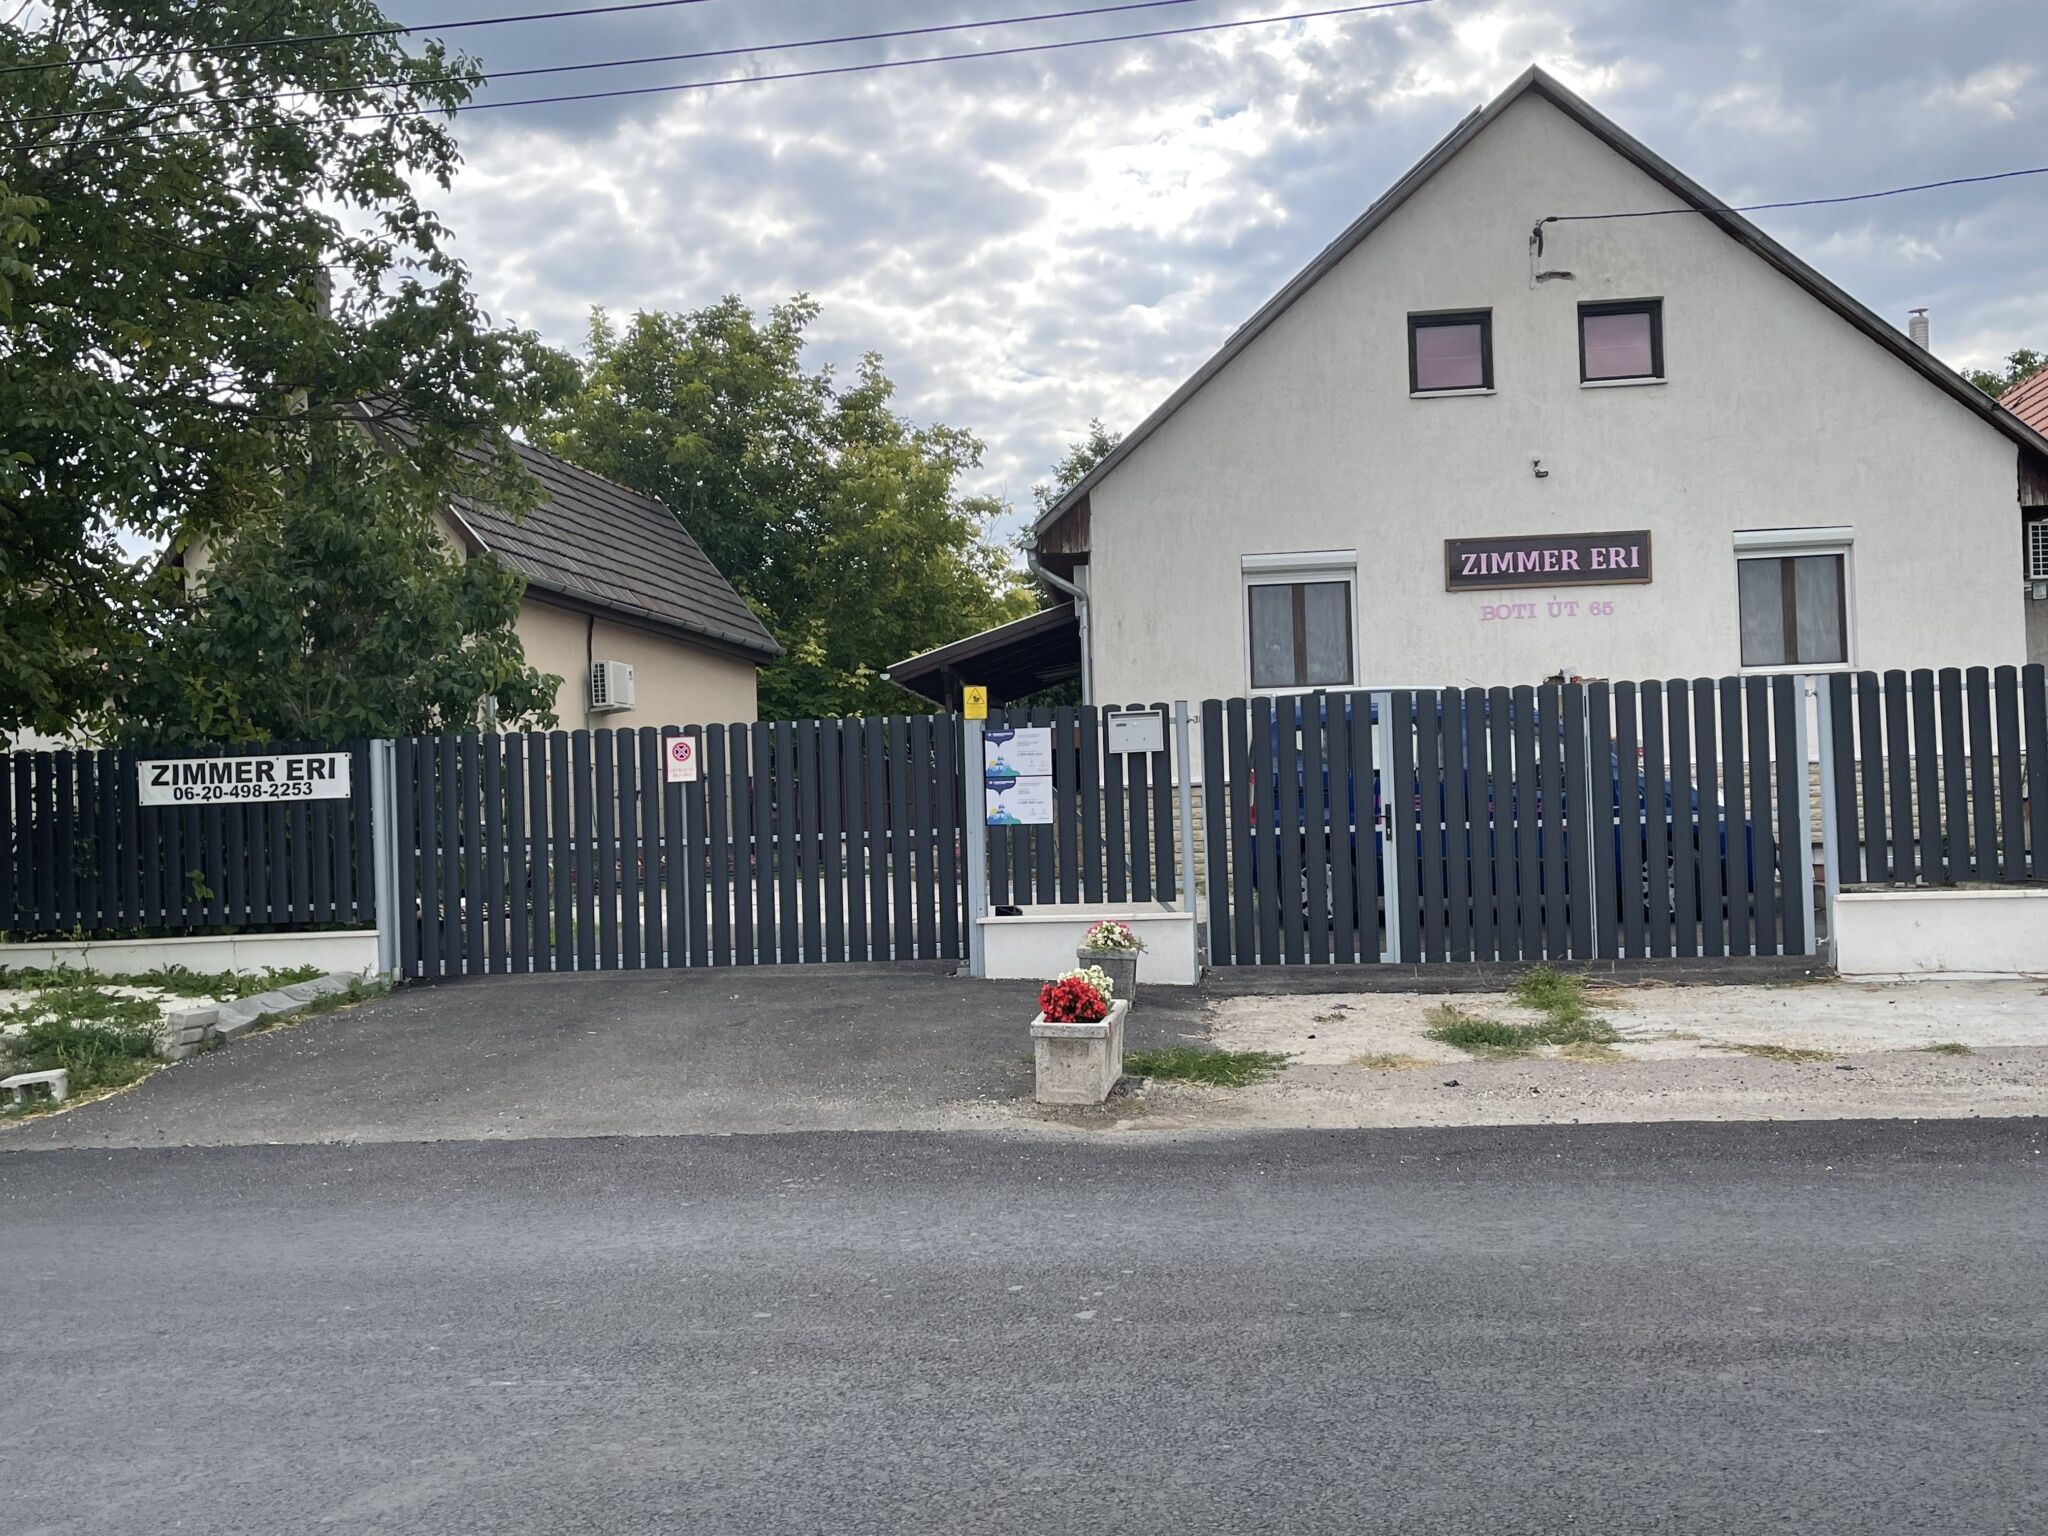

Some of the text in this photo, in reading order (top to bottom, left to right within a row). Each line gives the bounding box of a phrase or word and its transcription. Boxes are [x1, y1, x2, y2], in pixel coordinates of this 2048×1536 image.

[1461, 546, 1640, 576] ZIMMER ERI
[1481, 603, 1537, 621] BOTI
[1589, 601, 1614, 616] 65
[151, 757, 336, 787] ZIMMER ERI
[173, 782, 313, 801] 06-20-498-2253
